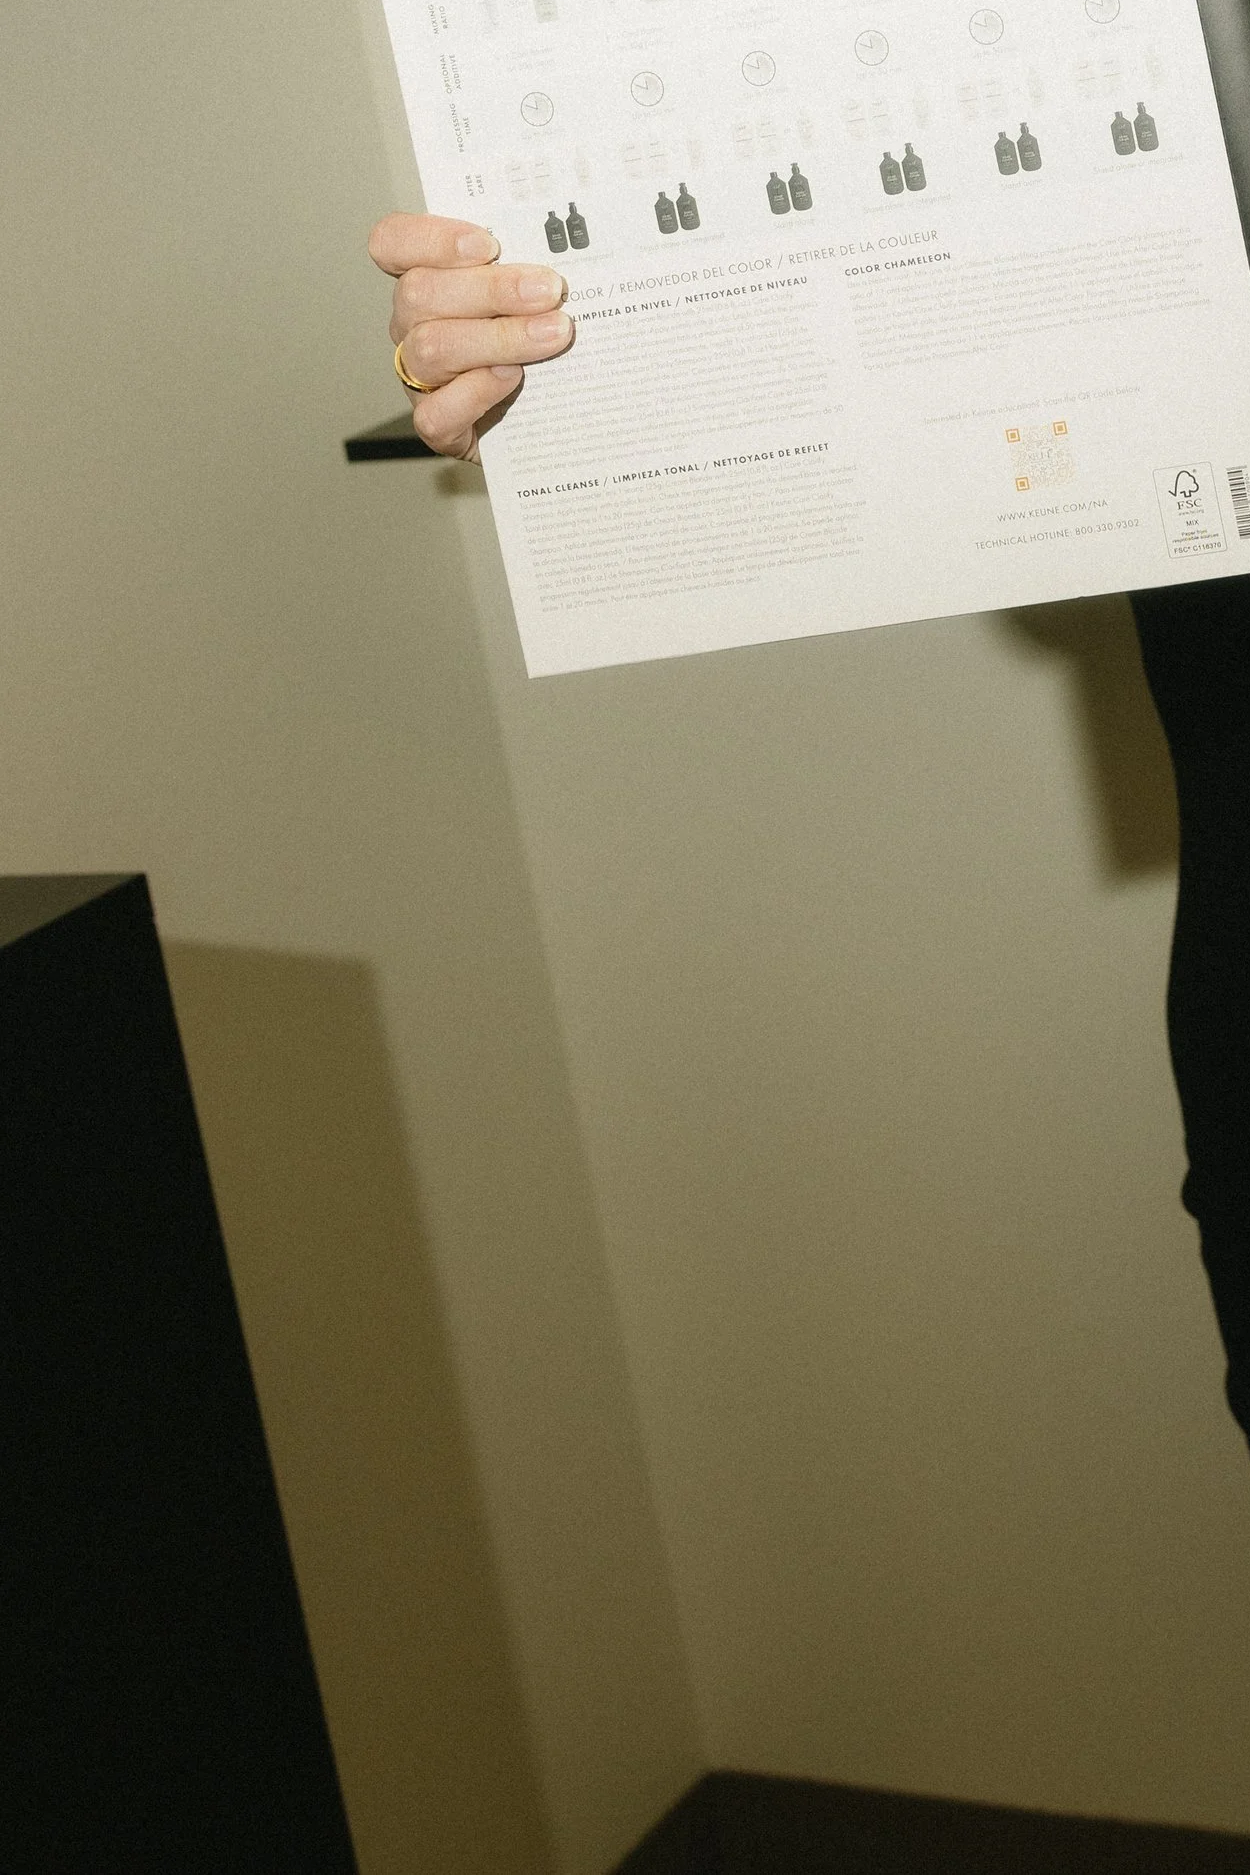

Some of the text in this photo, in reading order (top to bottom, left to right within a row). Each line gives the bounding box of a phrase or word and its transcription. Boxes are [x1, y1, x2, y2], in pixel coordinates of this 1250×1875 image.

[560, 287, 604, 303] COLOR
[619, 271, 699, 293] REMOVEDOR
[703, 266, 724, 279] DEL
[728, 258, 772, 275] COLOR
[788, 248, 835, 265] RETIRER
[839, 244, 855, 256] DE
[860, 241, 875, 253] LA
[878, 230, 938, 250] COULEUR
[844, 252, 951, 277] COLOR CHAMELEON
[573, 308, 621, 322] LIMPIEZA
[625, 305, 637, 314] DE
[641, 299, 671, 311] NIVEL
[685, 287, 747, 303] NETTOYAGE
[750, 284, 763, 293] DE
[766, 277, 808, 290] NIVEAU
[517, 487, 551, 499] TONAL
[554, 479, 599, 493] CLEANSE
[612, 469, 661, 484] LIMPIEZA
[664, 464, 699, 476] TONAL
[713, 452, 775, 468] NETTOYAGE
[778, 449, 791, 458] DE
[794, 443, 829, 456] REFLET
[996, 499, 1108, 523] WWW.KEUNE.COM/NA
[1176, 498, 1203, 510] FSC
[975, 518, 1140, 551] TECHNICAL HOTLINE: 800.330.9302
[1186, 519, 1199, 527] MIX
